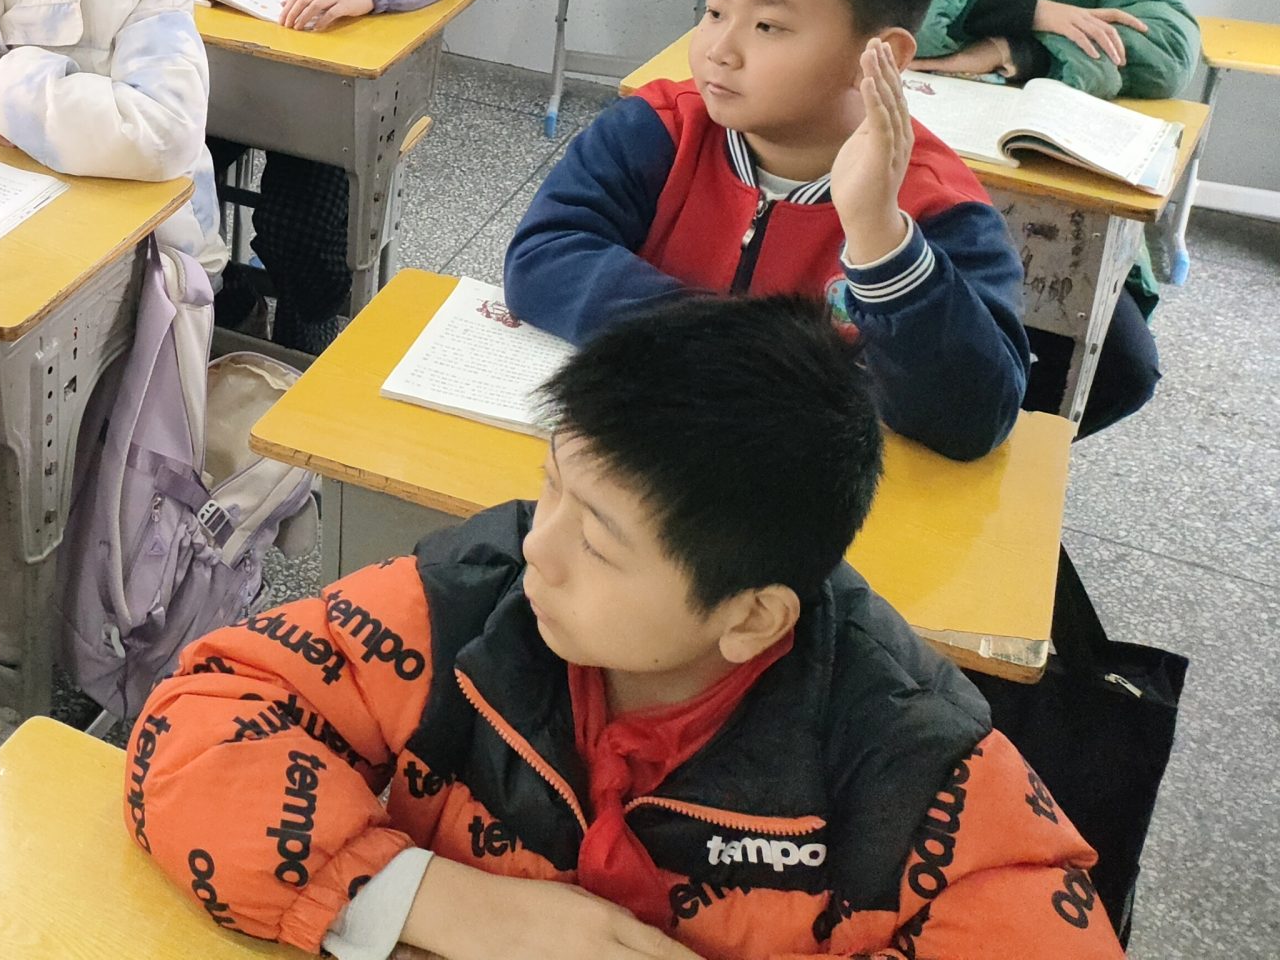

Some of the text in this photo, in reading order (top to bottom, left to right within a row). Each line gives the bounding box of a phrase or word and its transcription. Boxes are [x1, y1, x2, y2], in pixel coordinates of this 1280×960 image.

[325, 589, 426, 681] tempo
[266, 749, 327, 888] tempo
[706, 834, 827, 872] tempo
